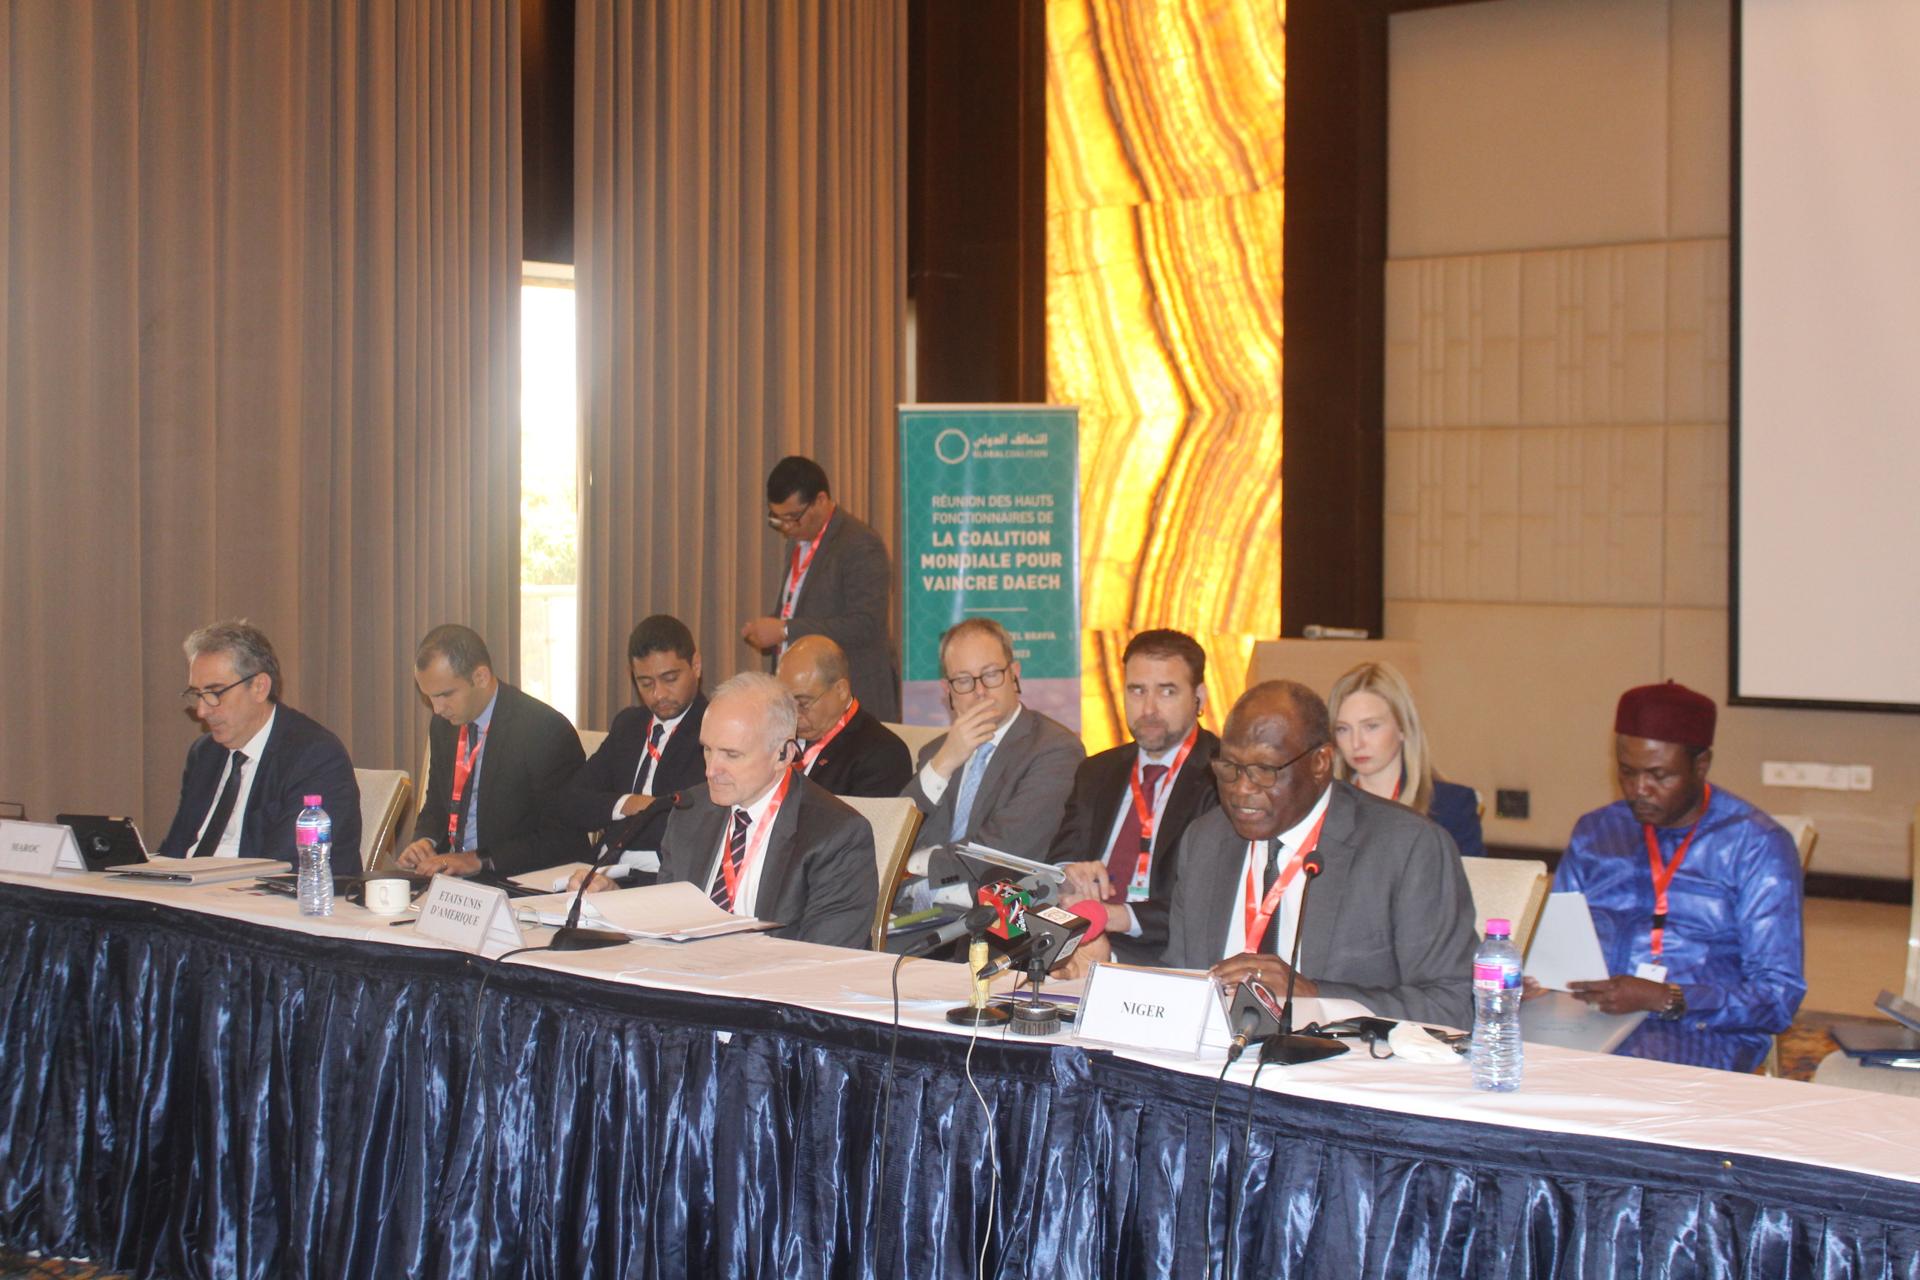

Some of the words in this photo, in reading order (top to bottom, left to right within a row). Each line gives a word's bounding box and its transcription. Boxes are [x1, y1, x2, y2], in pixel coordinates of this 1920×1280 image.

[932, 494, 985, 507] RÉUNION
[988, 495, 1012, 507] DES
[1015, 494, 1054, 507] HAUTS
[932, 511, 1035, 524] FONCTIONNAIRES
[1037, 511, 1054, 524] DE
[932, 531, 954, 547] LA
[958, 530, 1051, 546] COALITION
[921, 552, 1011, 569] MONDIALE
[1016, 552, 1062, 568] POUR
[923, 575, 998, 591] VAINCRE
[1002, 574, 1060, 590] DAECH
[439, 890, 463, 904] ETATS
[463, 896, 482, 910] UNIS
[430, 904, 480, 926] D'AMERIQUE
[1120, 1001, 1165, 1018] NIGER
